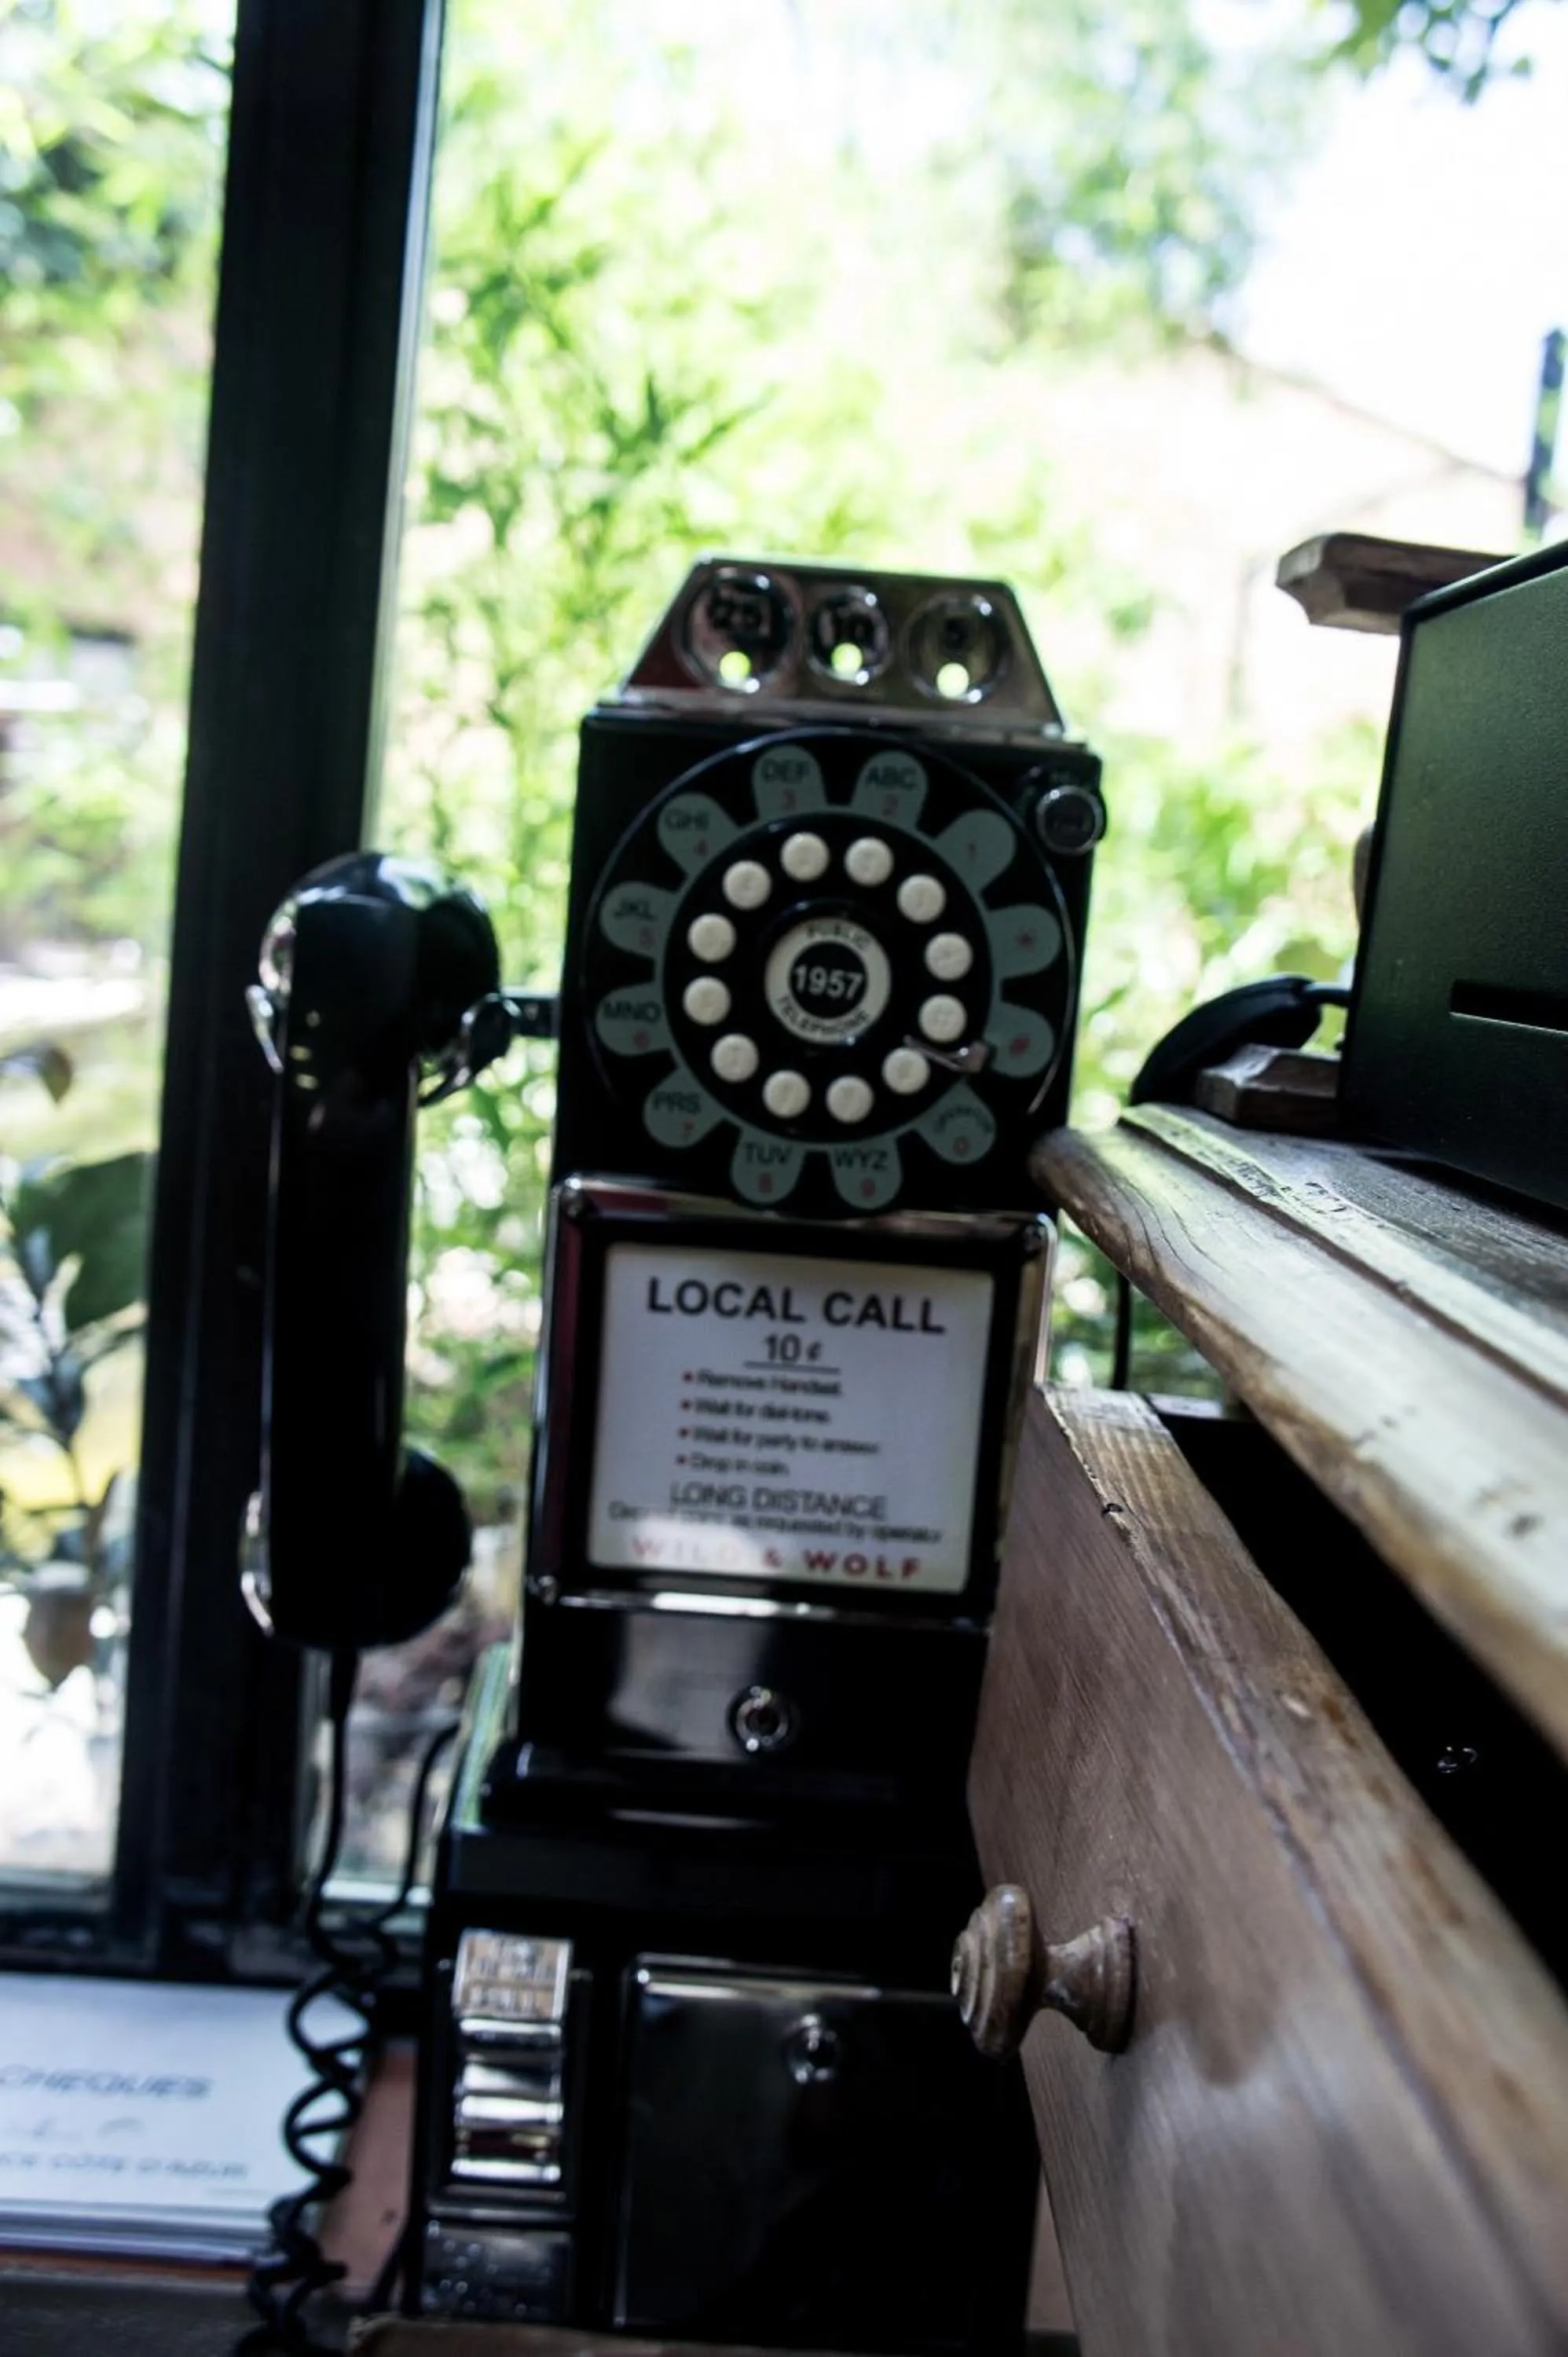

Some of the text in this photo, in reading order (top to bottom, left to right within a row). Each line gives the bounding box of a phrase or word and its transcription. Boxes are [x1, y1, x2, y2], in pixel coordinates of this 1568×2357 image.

[762, 759, 809, 783] DEF
[866, 765, 917, 790] ABC
[794, 963, 864, 1002] 1957
[603, 1002, 661, 1024] MNO
[653, 1091, 702, 1114] PRS
[746, 1142, 791, 1165] TUV
[834, 1149, 888, 1171] WYZ
[647, 1276, 947, 1336] LOCAL CALL
[764, 1333, 801, 1363] 10
[735, 1402, 754, 1419] for
[731, 1430, 753, 1447] for
[670, 1482, 747, 1510] LONG
[753, 1486, 888, 1521] DISTANCE
[802, 1549, 923, 1580] WOLF
